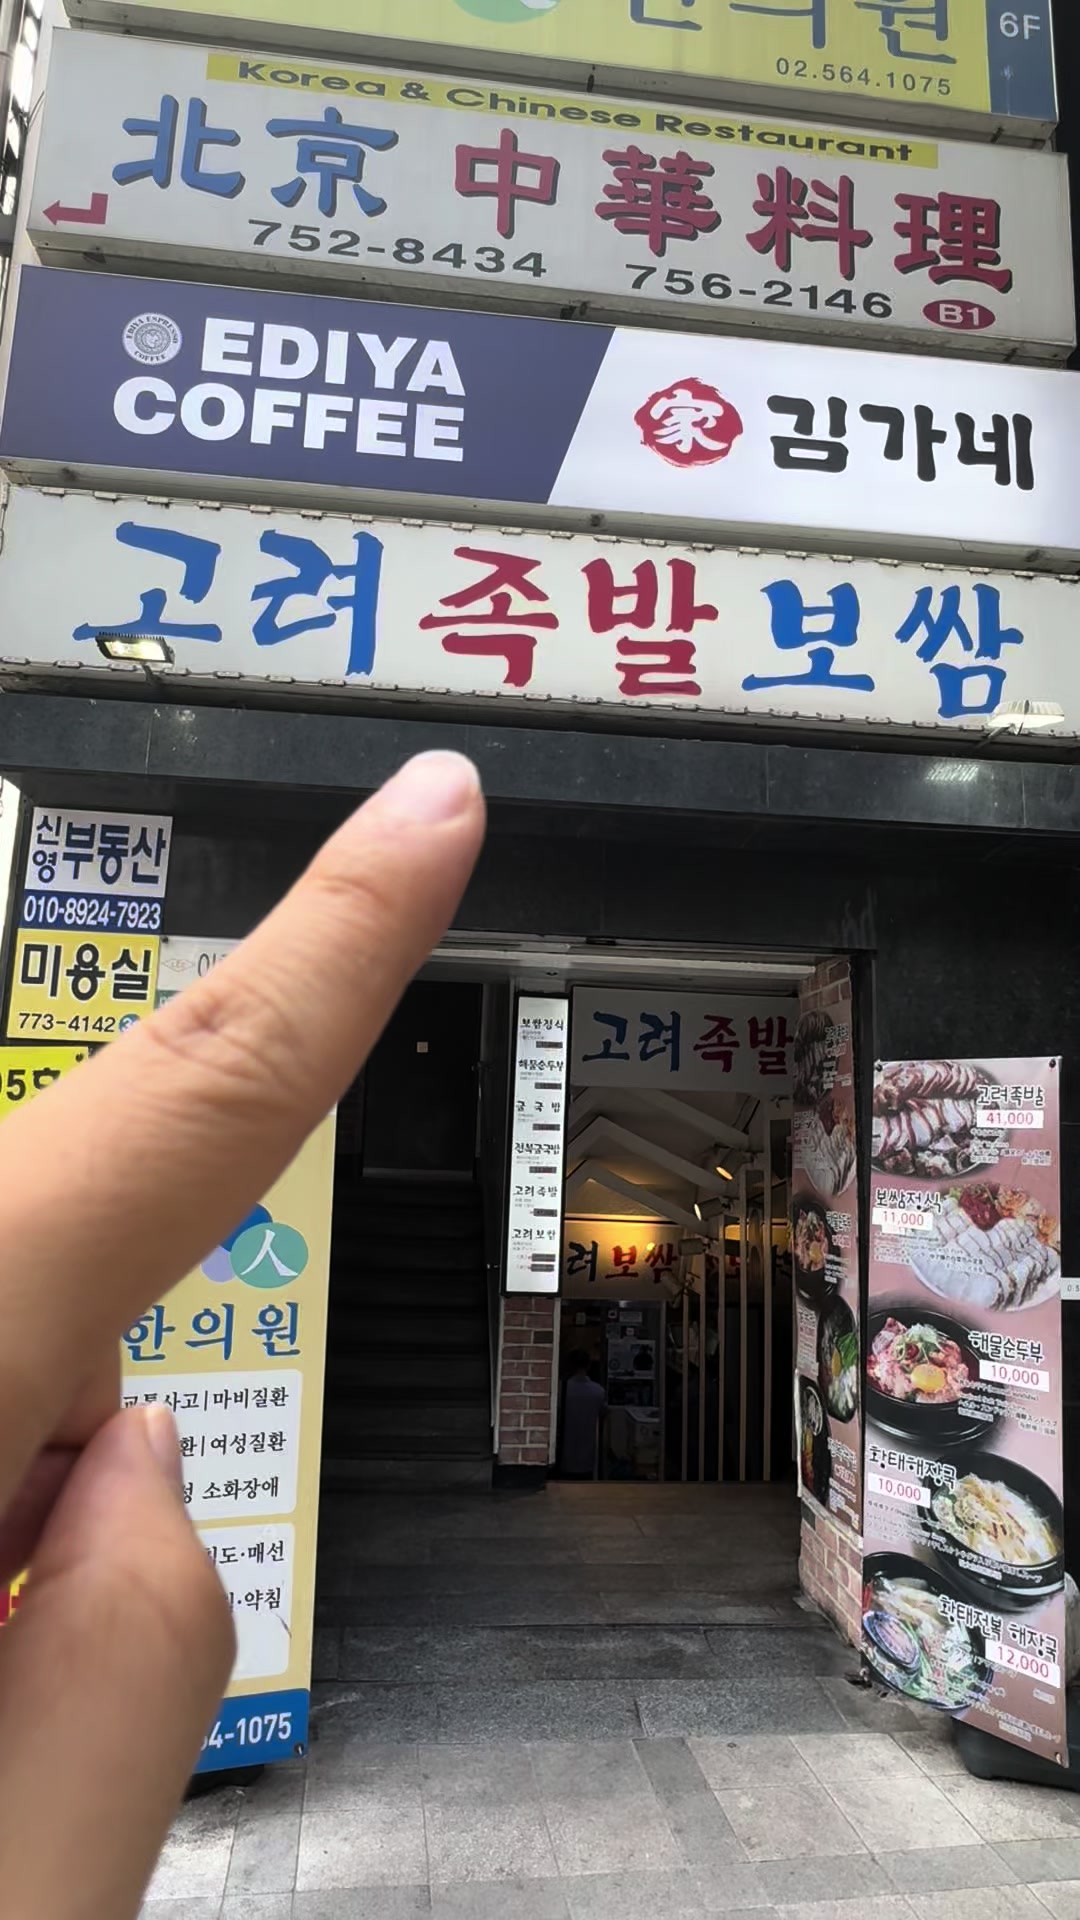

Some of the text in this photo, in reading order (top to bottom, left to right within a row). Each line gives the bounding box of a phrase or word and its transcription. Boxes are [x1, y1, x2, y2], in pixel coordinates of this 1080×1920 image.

[999, 12, 1041, 40] 6F
[775, 57, 952, 96] 02.564.1075
[238, 61, 912, 163] Korea & Chinese Restaurant
[112, 94, 1014, 295] 北京 中華料理
[247, 219, 548, 279] 752-8434
[624, 264, 893, 320] 756-2146
[938, 303, 983, 327] B1
[201, 317, 465, 396] EDIYA
[113, 375, 465, 462] COFFEE
[650, 389, 727, 455] 家
[767, 395, 1034, 490] 김가네
[64, 821, 166, 886] 부동산
[24, 895, 162, 929] 010-8924-7923
[20, 943, 152, 1001] 미용실
[19, 1012, 116, 1033] 773-4142
[582, 1010, 794, 1076] 고려족발
[977, 1085, 1044, 1107] 고려족발
[986, 1112, 1034, 1126] 41,000
[876, 1188, 942, 1213] 보쌈정식
[882, 1210, 924, 1227] 11,000
[122, 1302, 302, 1362] 한의원
[969, 1332, 1043, 1363] 해물순두부
[991, 1364, 1040, 1386] 10,000
[212, 1386, 289, 1412] 마비질환
[210, 1430, 287, 1455] 여성질환
[869, 1445, 956, 1490] 황태해장국
[202, 1476, 279, 1500] 소화장애
[879, 1478, 922, 1501] 10,000
[939, 1594, 1058, 1664] 황태전복 해장국
[998, 1646, 1050, 1678] 12,000
[200, 1711, 292, 1751] 4-1075
